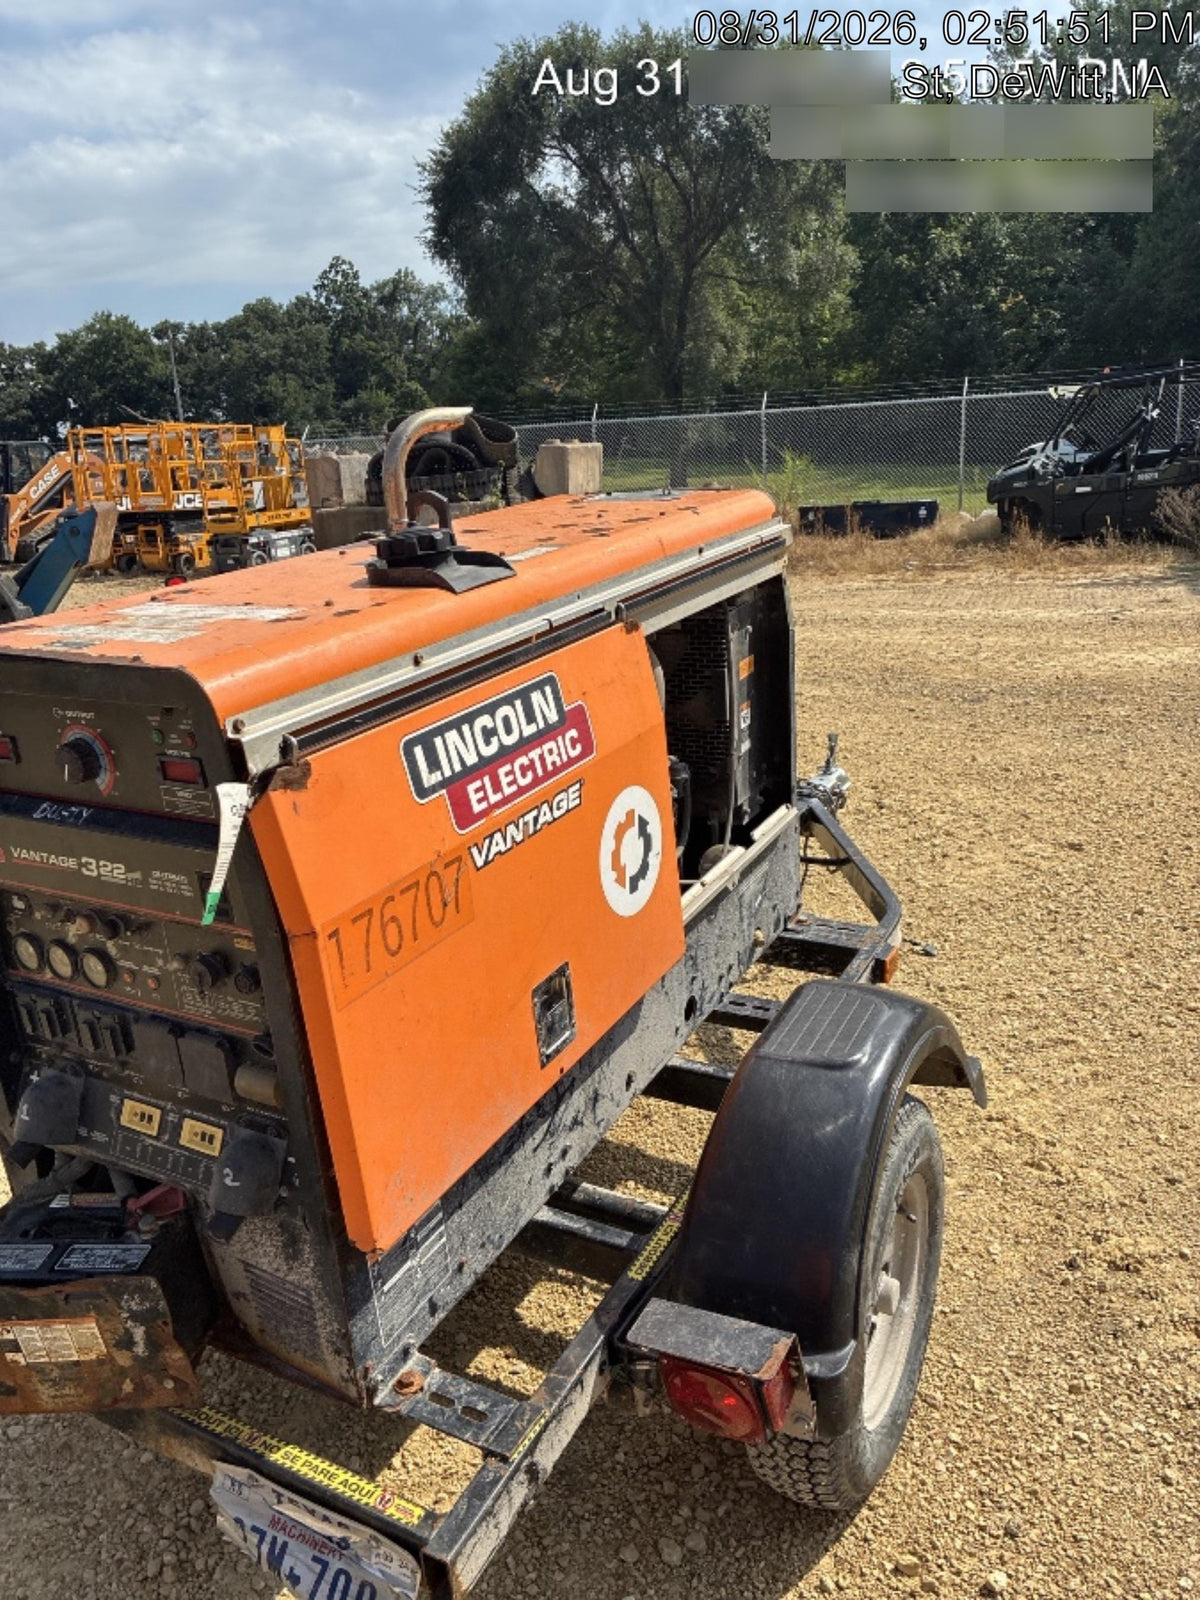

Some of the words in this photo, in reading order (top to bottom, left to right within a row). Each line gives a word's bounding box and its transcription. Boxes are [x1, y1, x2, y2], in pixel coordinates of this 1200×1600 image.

[29, 464, 61, 500] CASE
[413, 685, 561, 790] LINCOLN
[467, 728, 583, 815] ELECTRIC
[10, 846, 79, 870] VANTAGE
[81, 856, 127, 879] 322
[469, 780, 584, 871] VANTAGE
[327, 855, 464, 991] 176707
[259, 1438, 281, 1455] NO
[282, 1448, 299, 1466] SE
[301, 1457, 338, 1485] PARE
